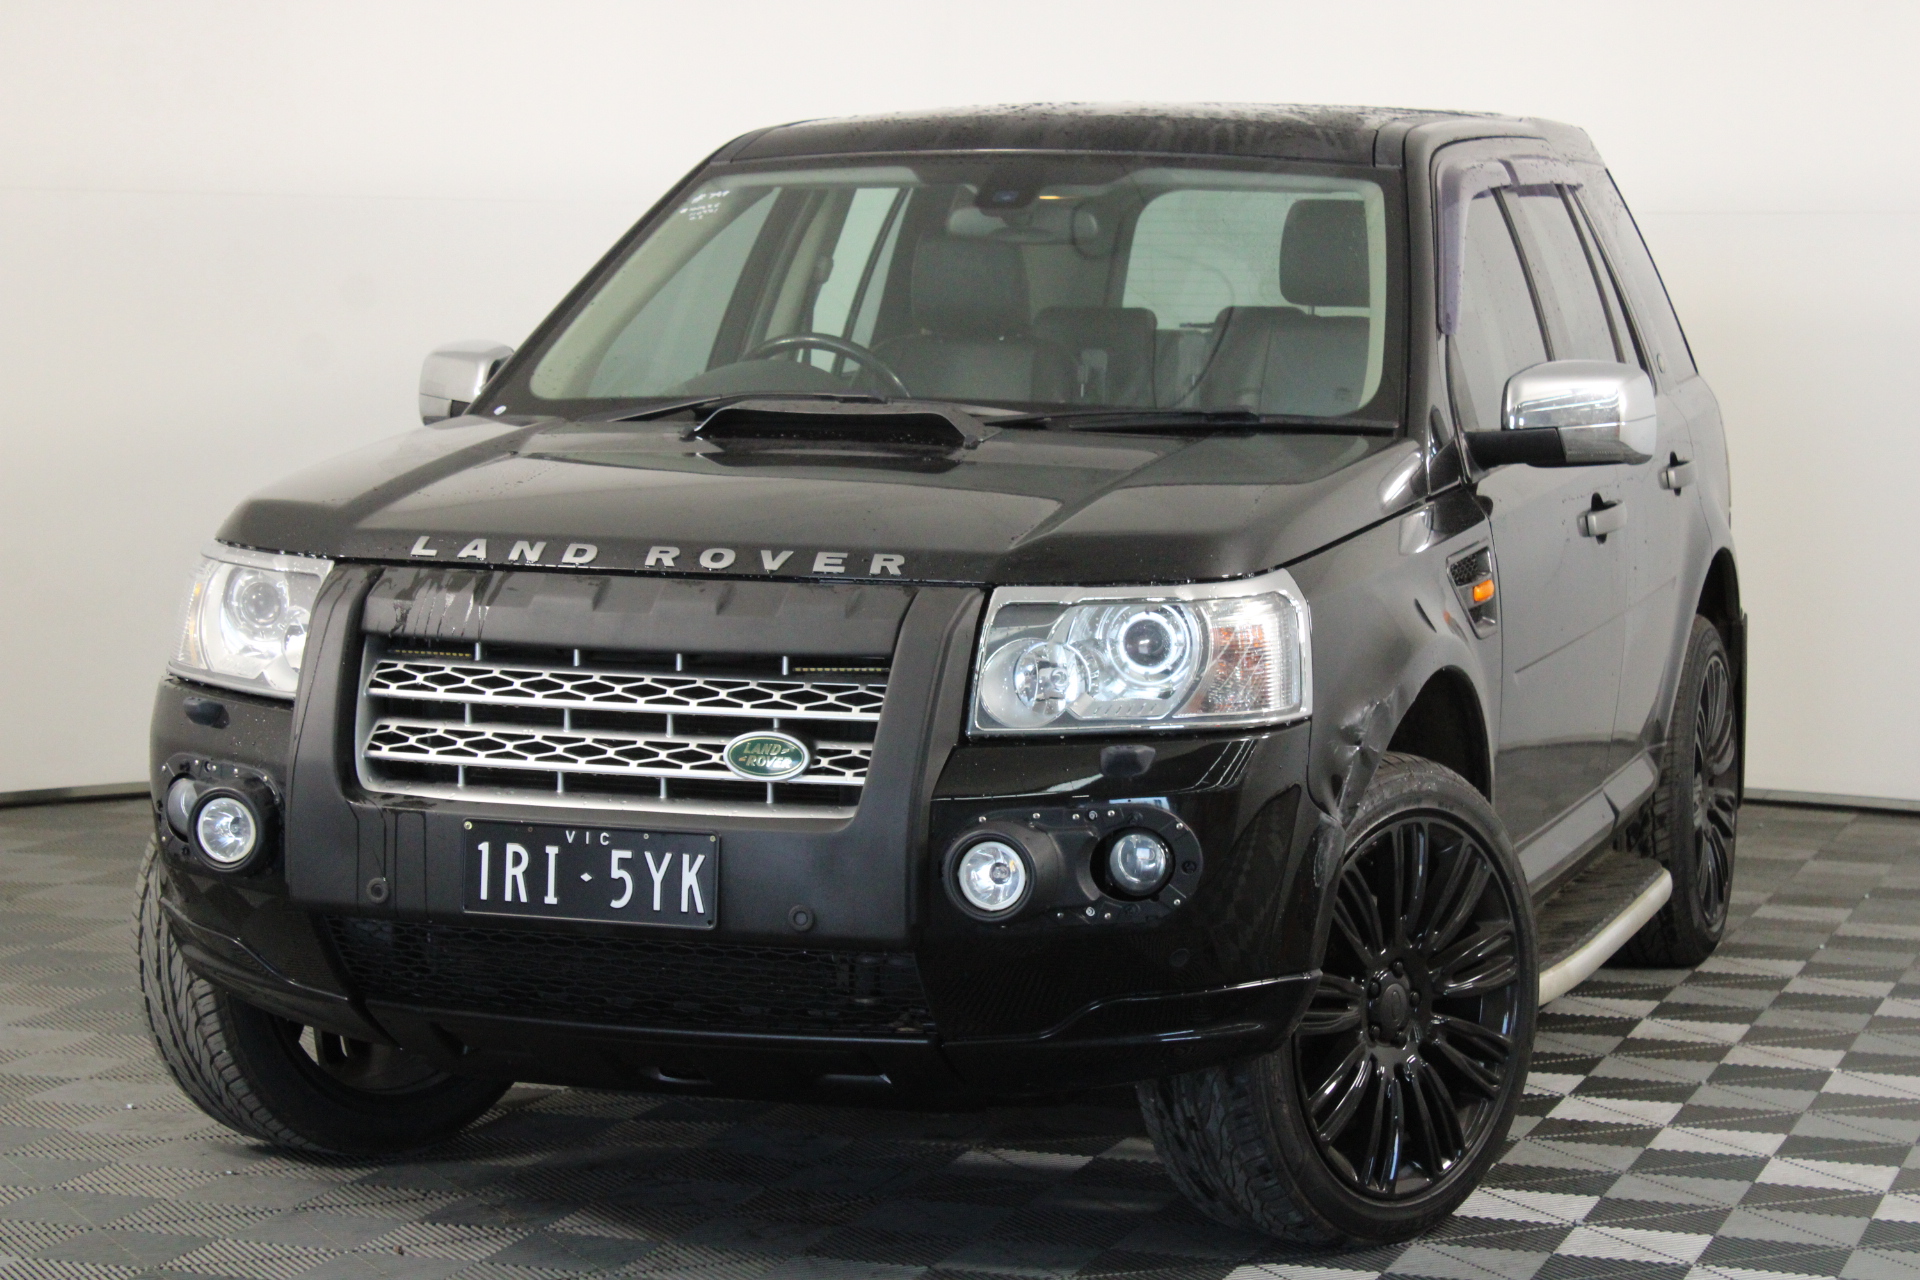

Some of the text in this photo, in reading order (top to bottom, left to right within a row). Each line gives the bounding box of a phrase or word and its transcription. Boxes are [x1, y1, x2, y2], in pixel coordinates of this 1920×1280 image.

[410, 535, 905, 575] LAND ROVER
[744, 743, 781, 755] LAND
[746, 756, 792, 768] ROVER
[565, 830, 611, 846] VIC
